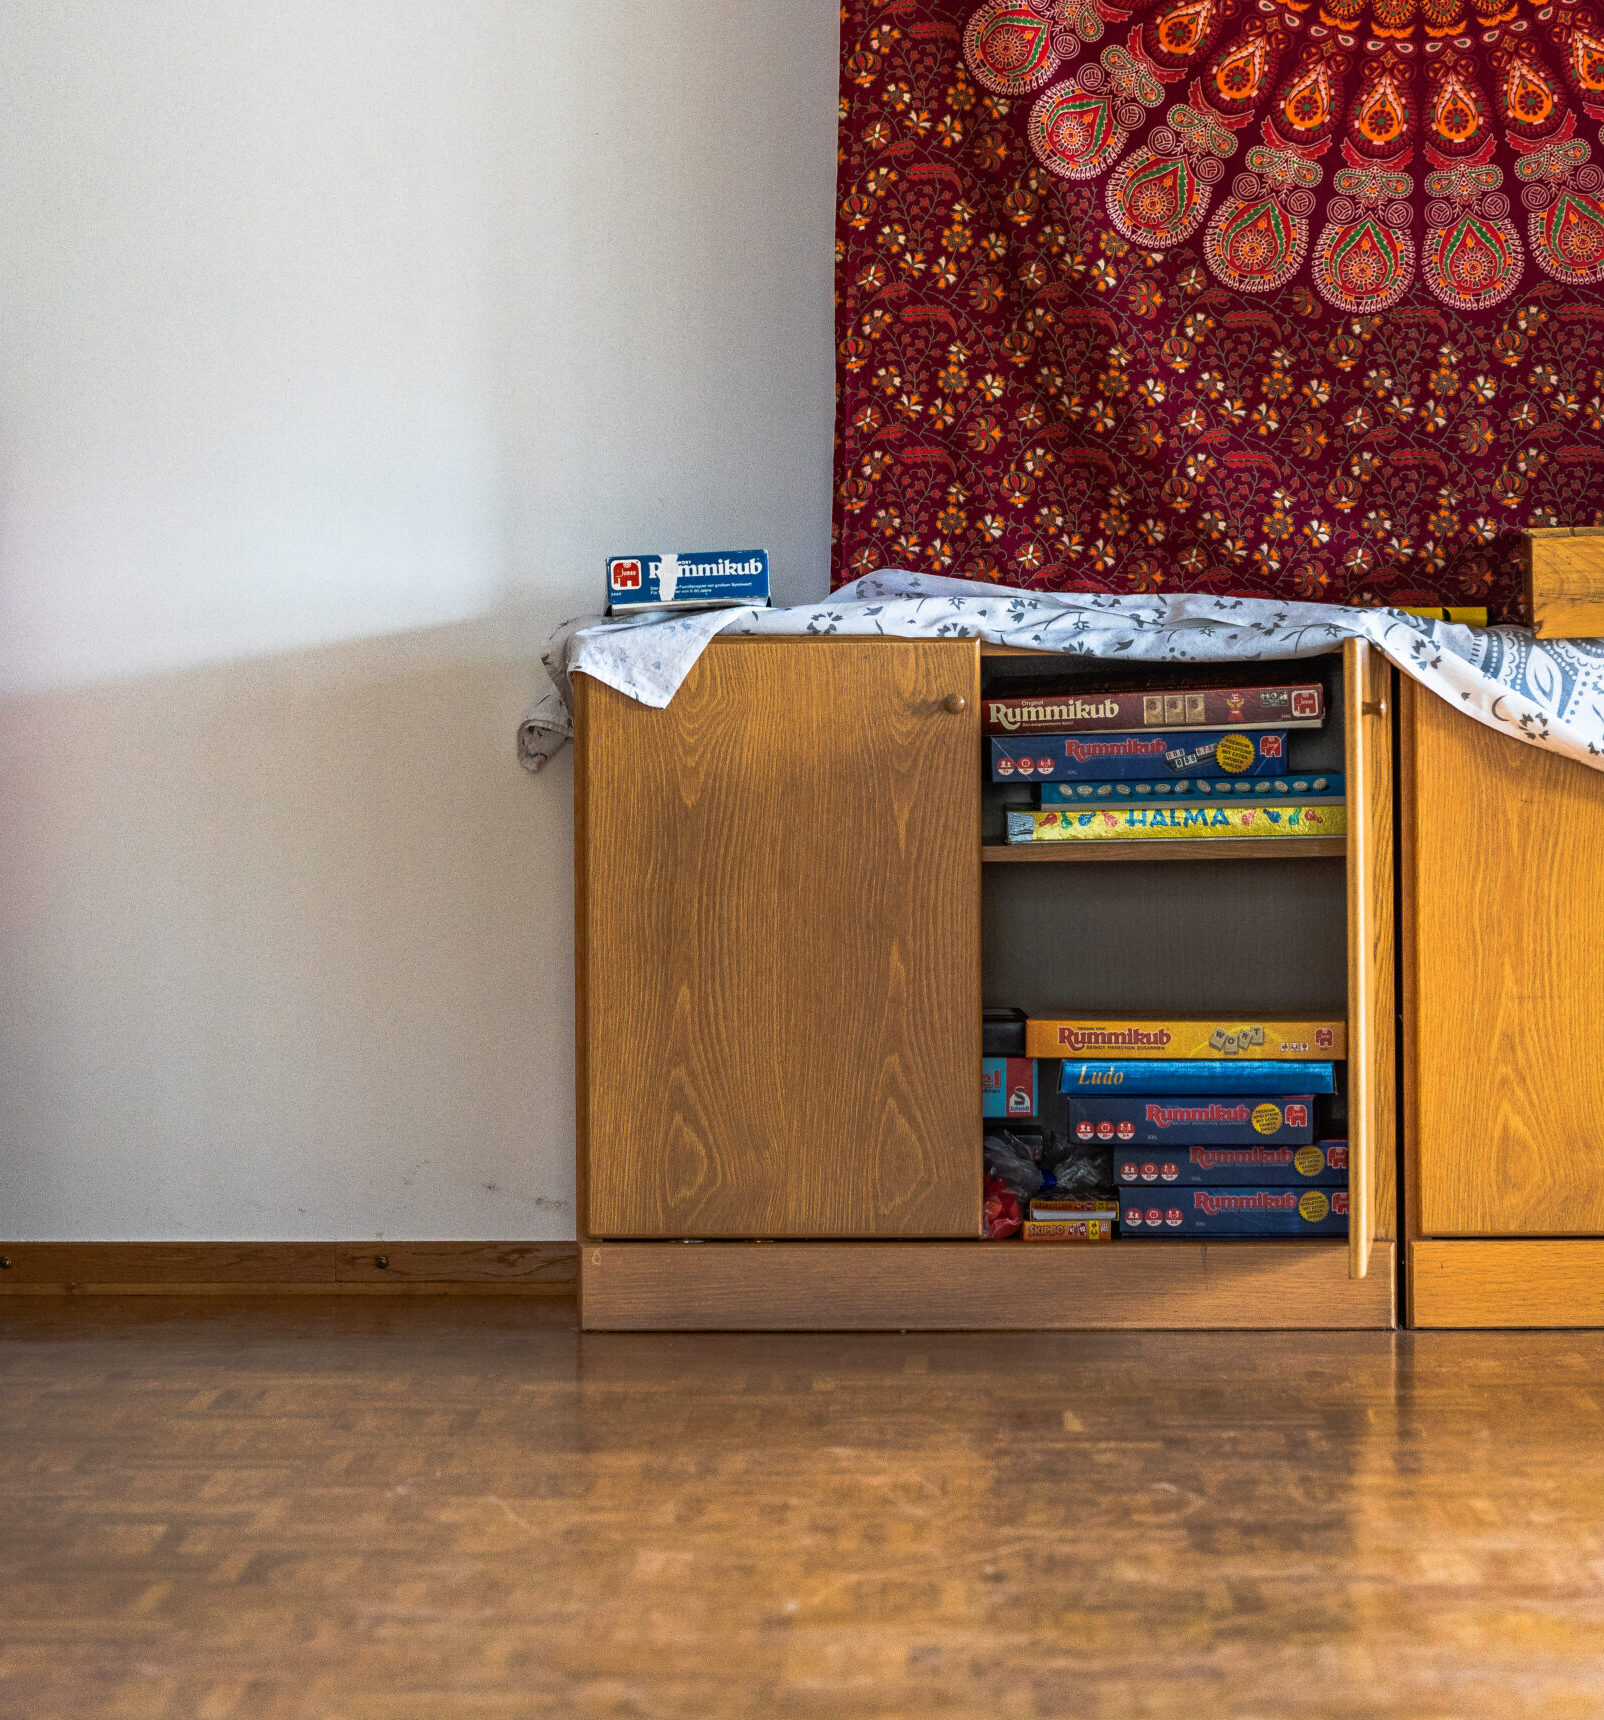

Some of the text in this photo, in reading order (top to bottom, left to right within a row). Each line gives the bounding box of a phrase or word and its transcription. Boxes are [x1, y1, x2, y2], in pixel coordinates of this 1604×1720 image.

[649, 558, 764, 579] Rmmikub
[988, 699, 1120, 731] Rummikub
[1064, 738, 1167, 763] Rummikub
[1125, 808, 1230, 828] HALMA
[1058, 1027, 1172, 1051] Rummikub
[1078, 1064, 1124, 1085] Ludo
[1146, 1104, 1249, 1128] Rummikub
[1189, 1146, 1294, 1170] Rummikub
[1194, 1191, 1298, 1215] Rummikub
